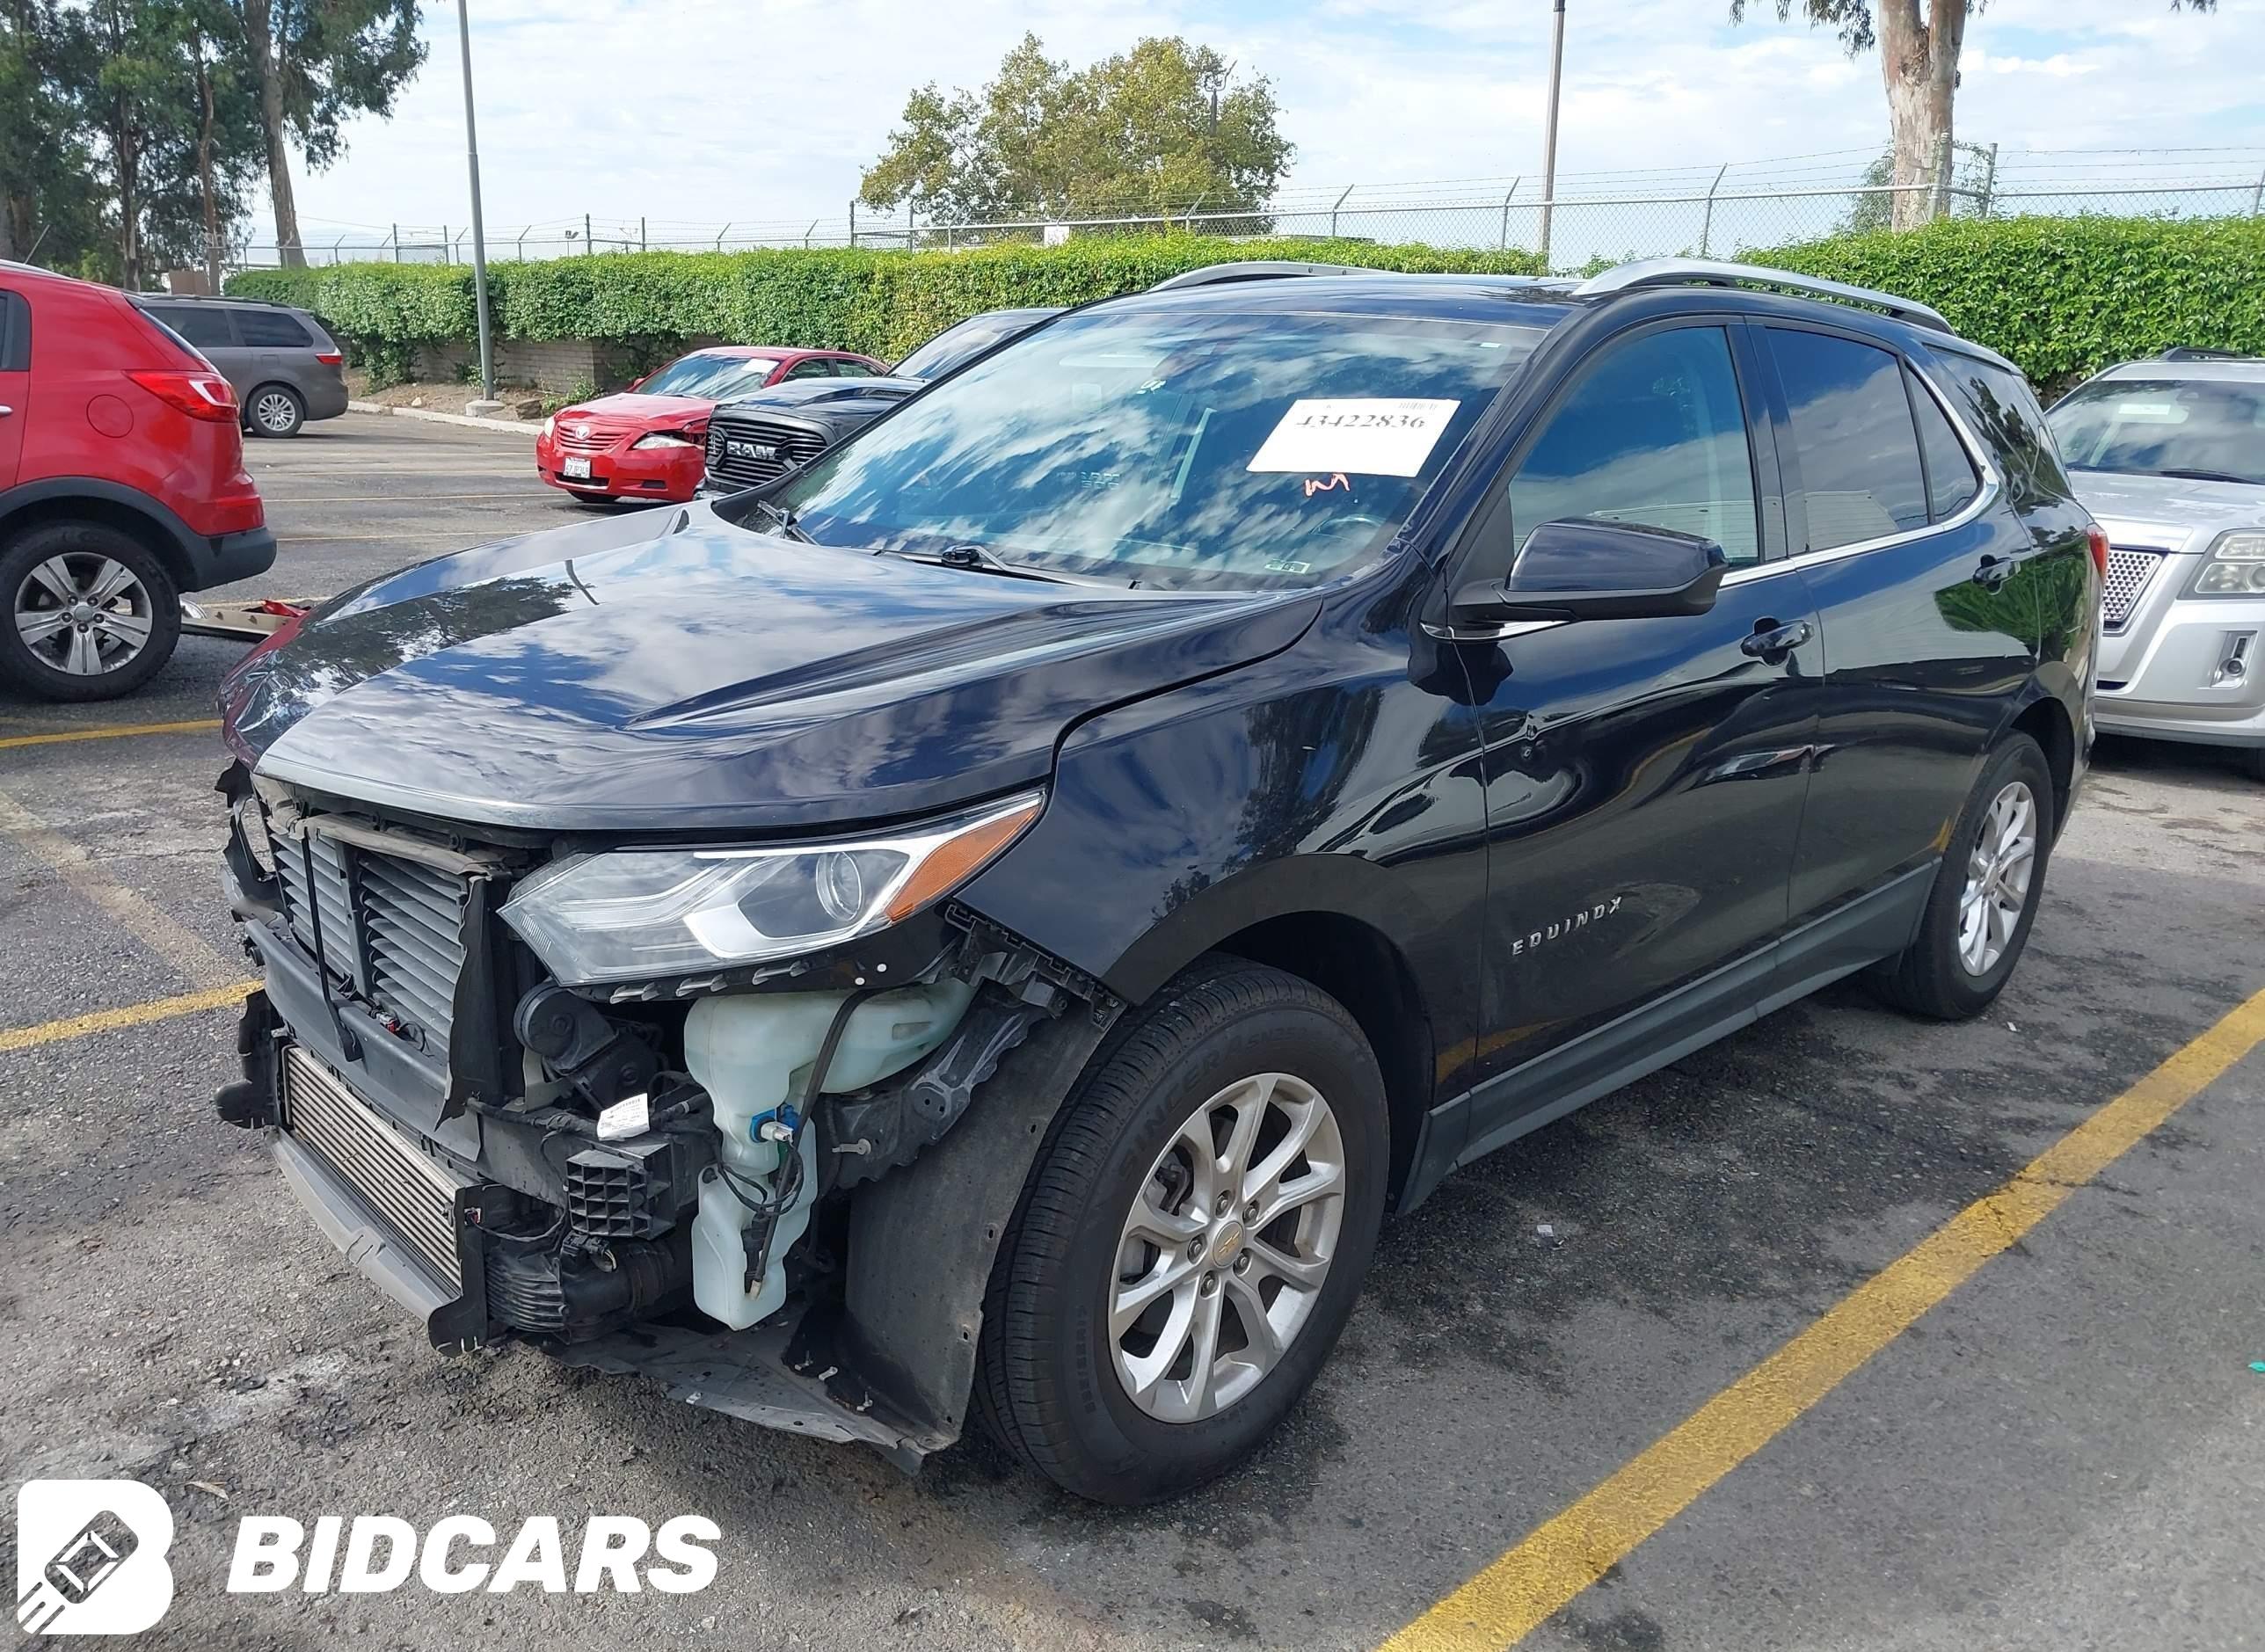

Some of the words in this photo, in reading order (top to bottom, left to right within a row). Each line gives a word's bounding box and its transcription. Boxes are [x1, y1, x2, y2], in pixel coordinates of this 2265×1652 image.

[1295, 414, 1426, 428] 43422836
[726, 440, 776, 461] RAM
[1511, 896, 1622, 956] EQUINOX
